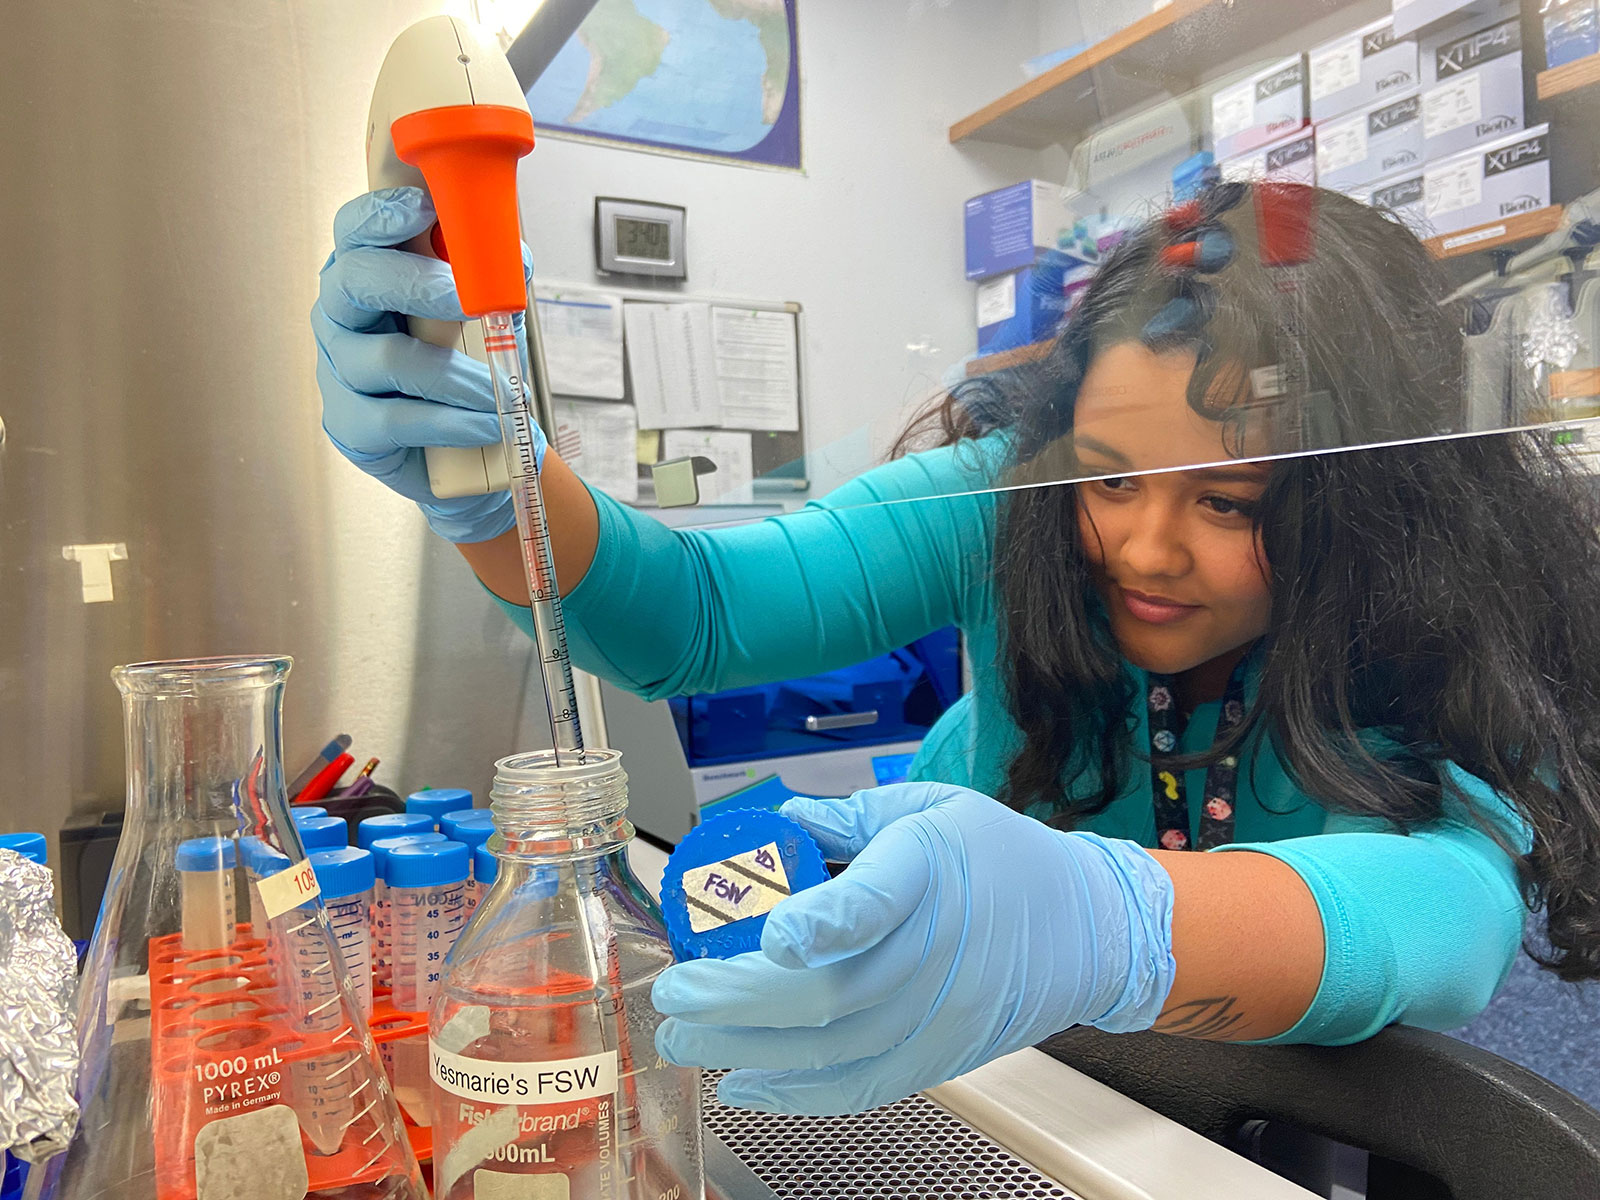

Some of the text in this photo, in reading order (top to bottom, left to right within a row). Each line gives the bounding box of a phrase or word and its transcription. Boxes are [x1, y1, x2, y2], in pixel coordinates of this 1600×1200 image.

[1438, 28, 1511, 72] XTIP4
[1487, 140, 1543, 171] XTIP4
[532, 589, 545, 600] 10
[551, 649, 560, 659] 9
[562, 708, 570, 719] 8
[293, 867, 316, 895] 109
[703, 872, 753, 905] FSW
[427, 909, 439, 919] 45
[427, 930, 440, 940] 40
[427, 952, 440, 961] 35
[427, 973, 440, 982] 30
[194, 1047, 284, 1083] 1000 mL
[432, 1053, 601, 1096] Yesmarie's FSW
[205, 1091, 281, 1116] Made in Germany
[597, 1100, 610, 1169] VOLUMES
